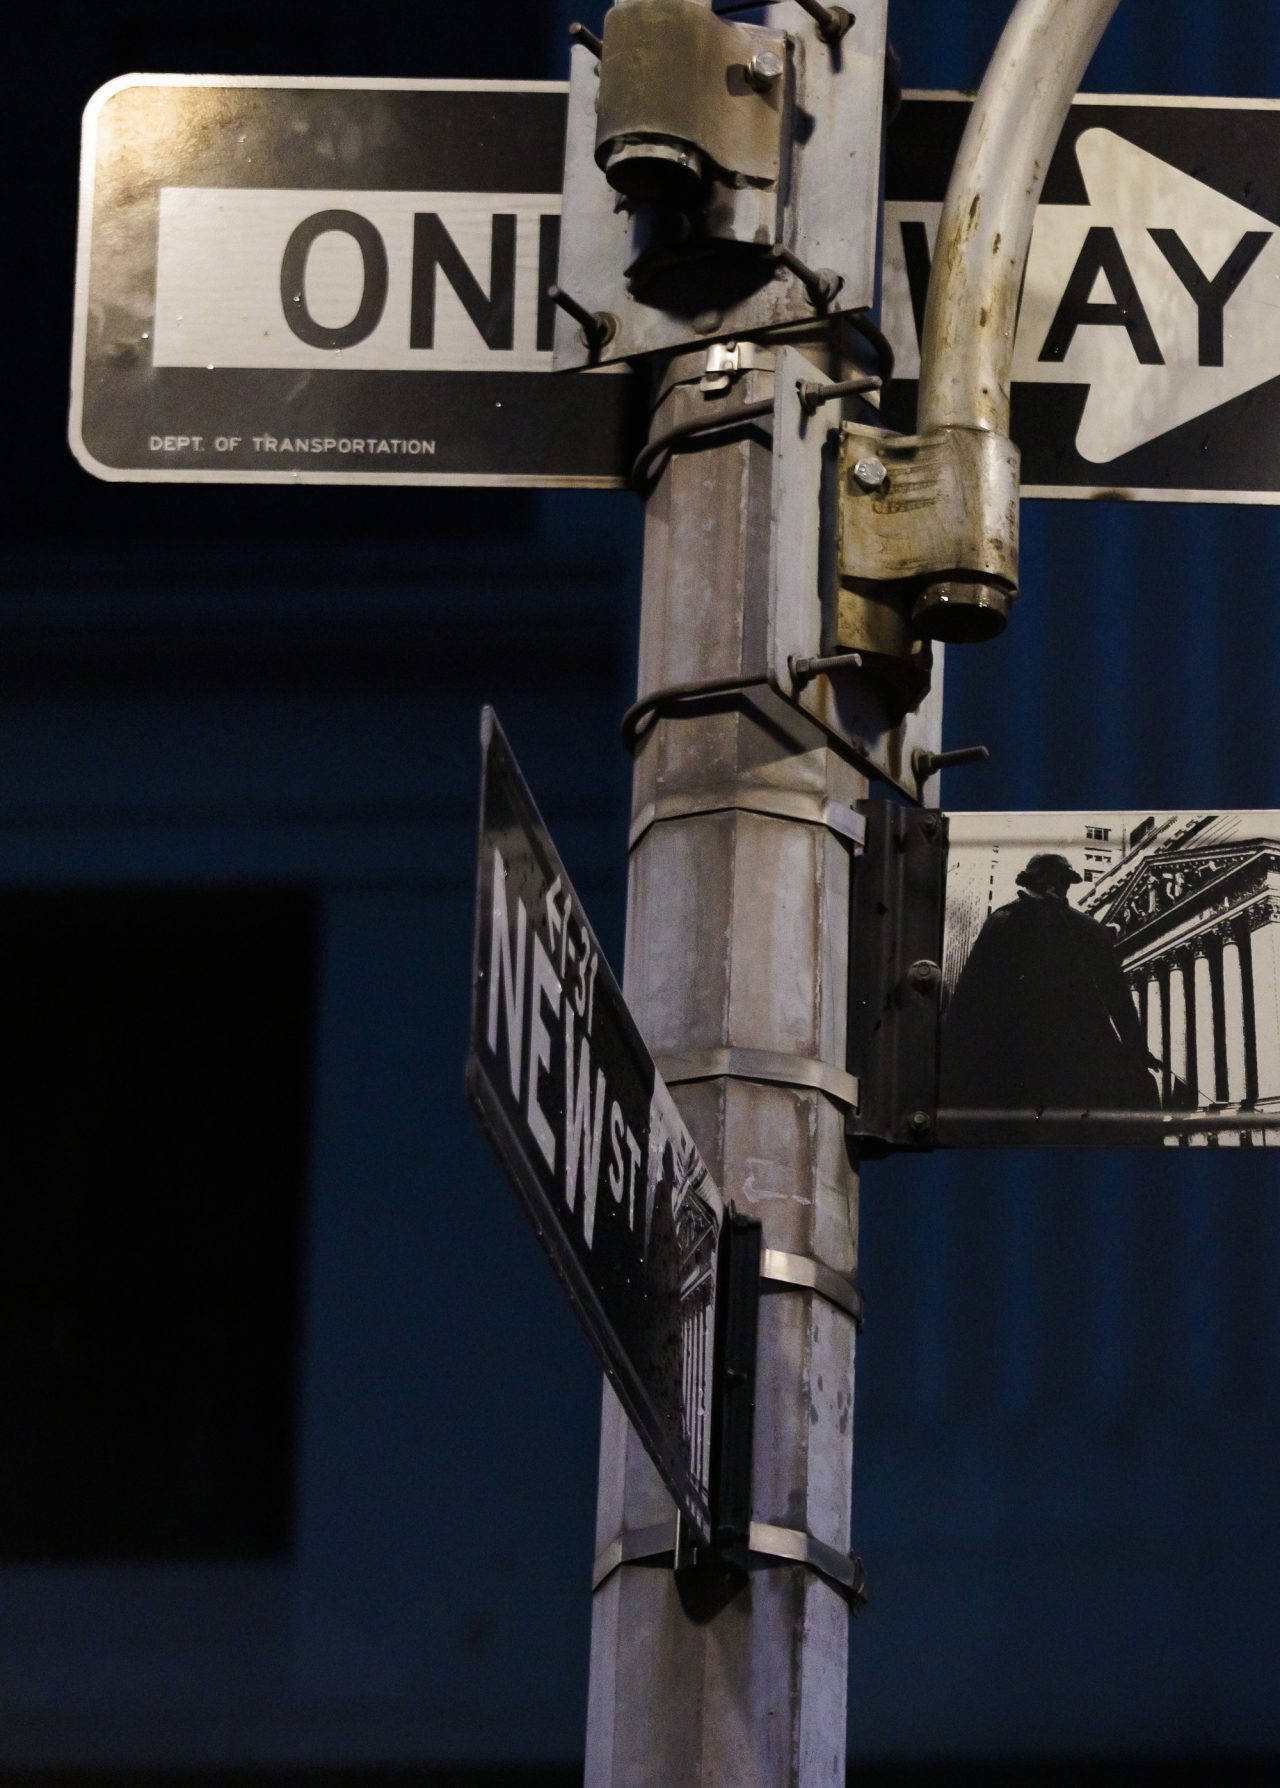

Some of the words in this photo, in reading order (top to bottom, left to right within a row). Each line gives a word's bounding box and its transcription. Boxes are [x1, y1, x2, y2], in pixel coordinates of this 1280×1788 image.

[150, 436, 205, 452] DEPT.
[214, 436, 242, 452] OF
[252, 437, 436, 454] TRANSPORTATION
[561, 893, 598, 1037] 1-31
[487, 847, 605, 1251] NEW
[608, 1100, 641, 1232] ST
